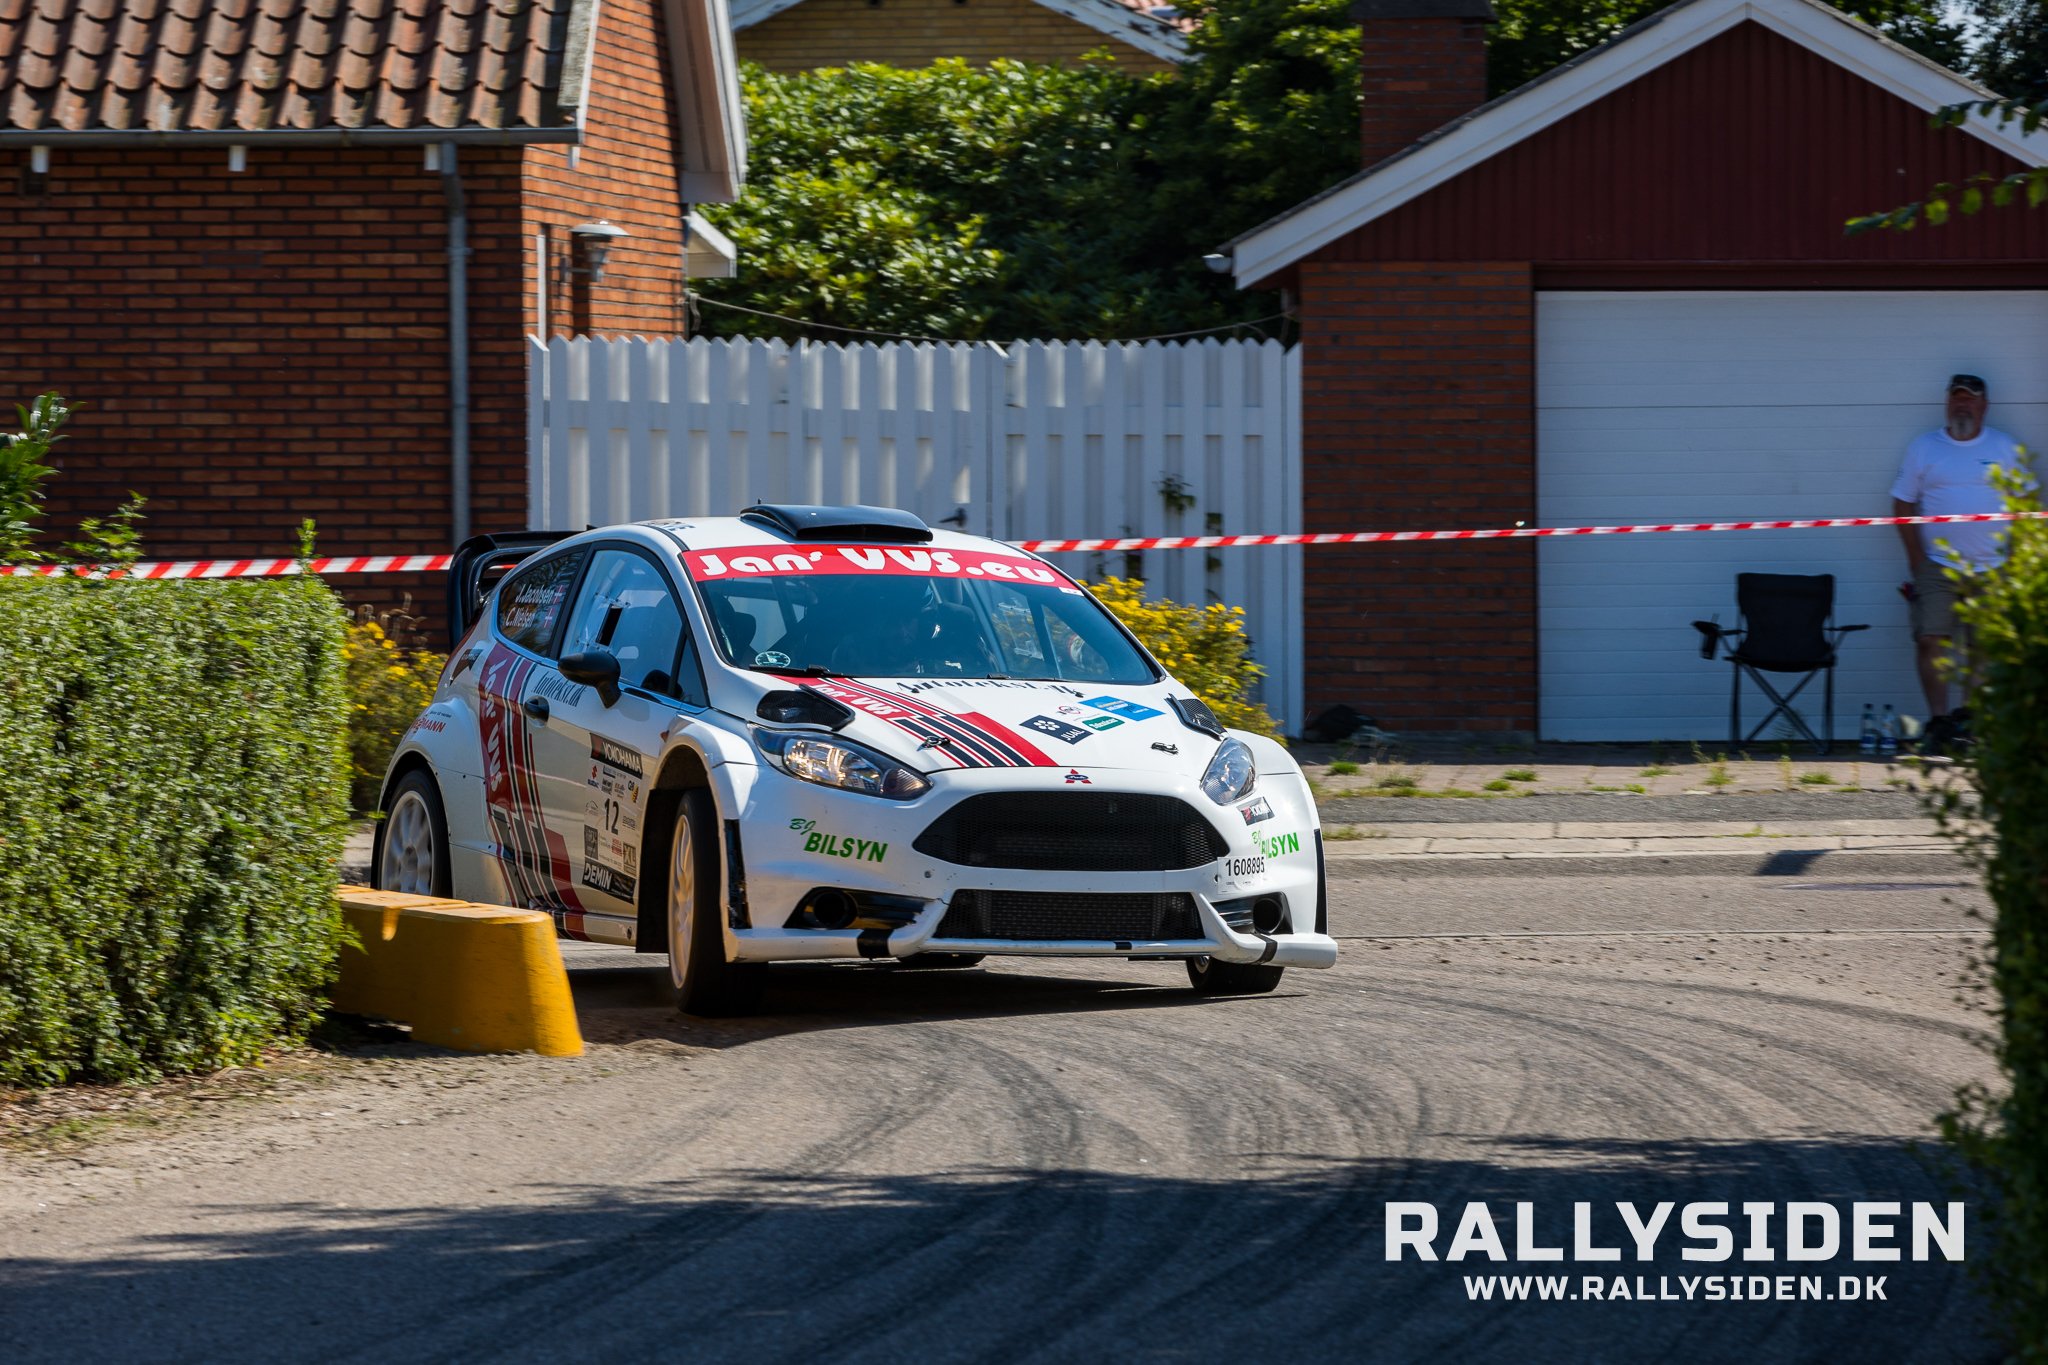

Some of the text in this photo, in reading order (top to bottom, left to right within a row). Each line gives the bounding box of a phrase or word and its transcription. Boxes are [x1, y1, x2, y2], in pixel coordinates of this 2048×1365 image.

[602, 741, 643, 774] YOKOHAMA
[604, 798, 620, 835] 12
[803, 832, 889, 863] BILSYN
[1225, 856, 1265, 877] 1608895
